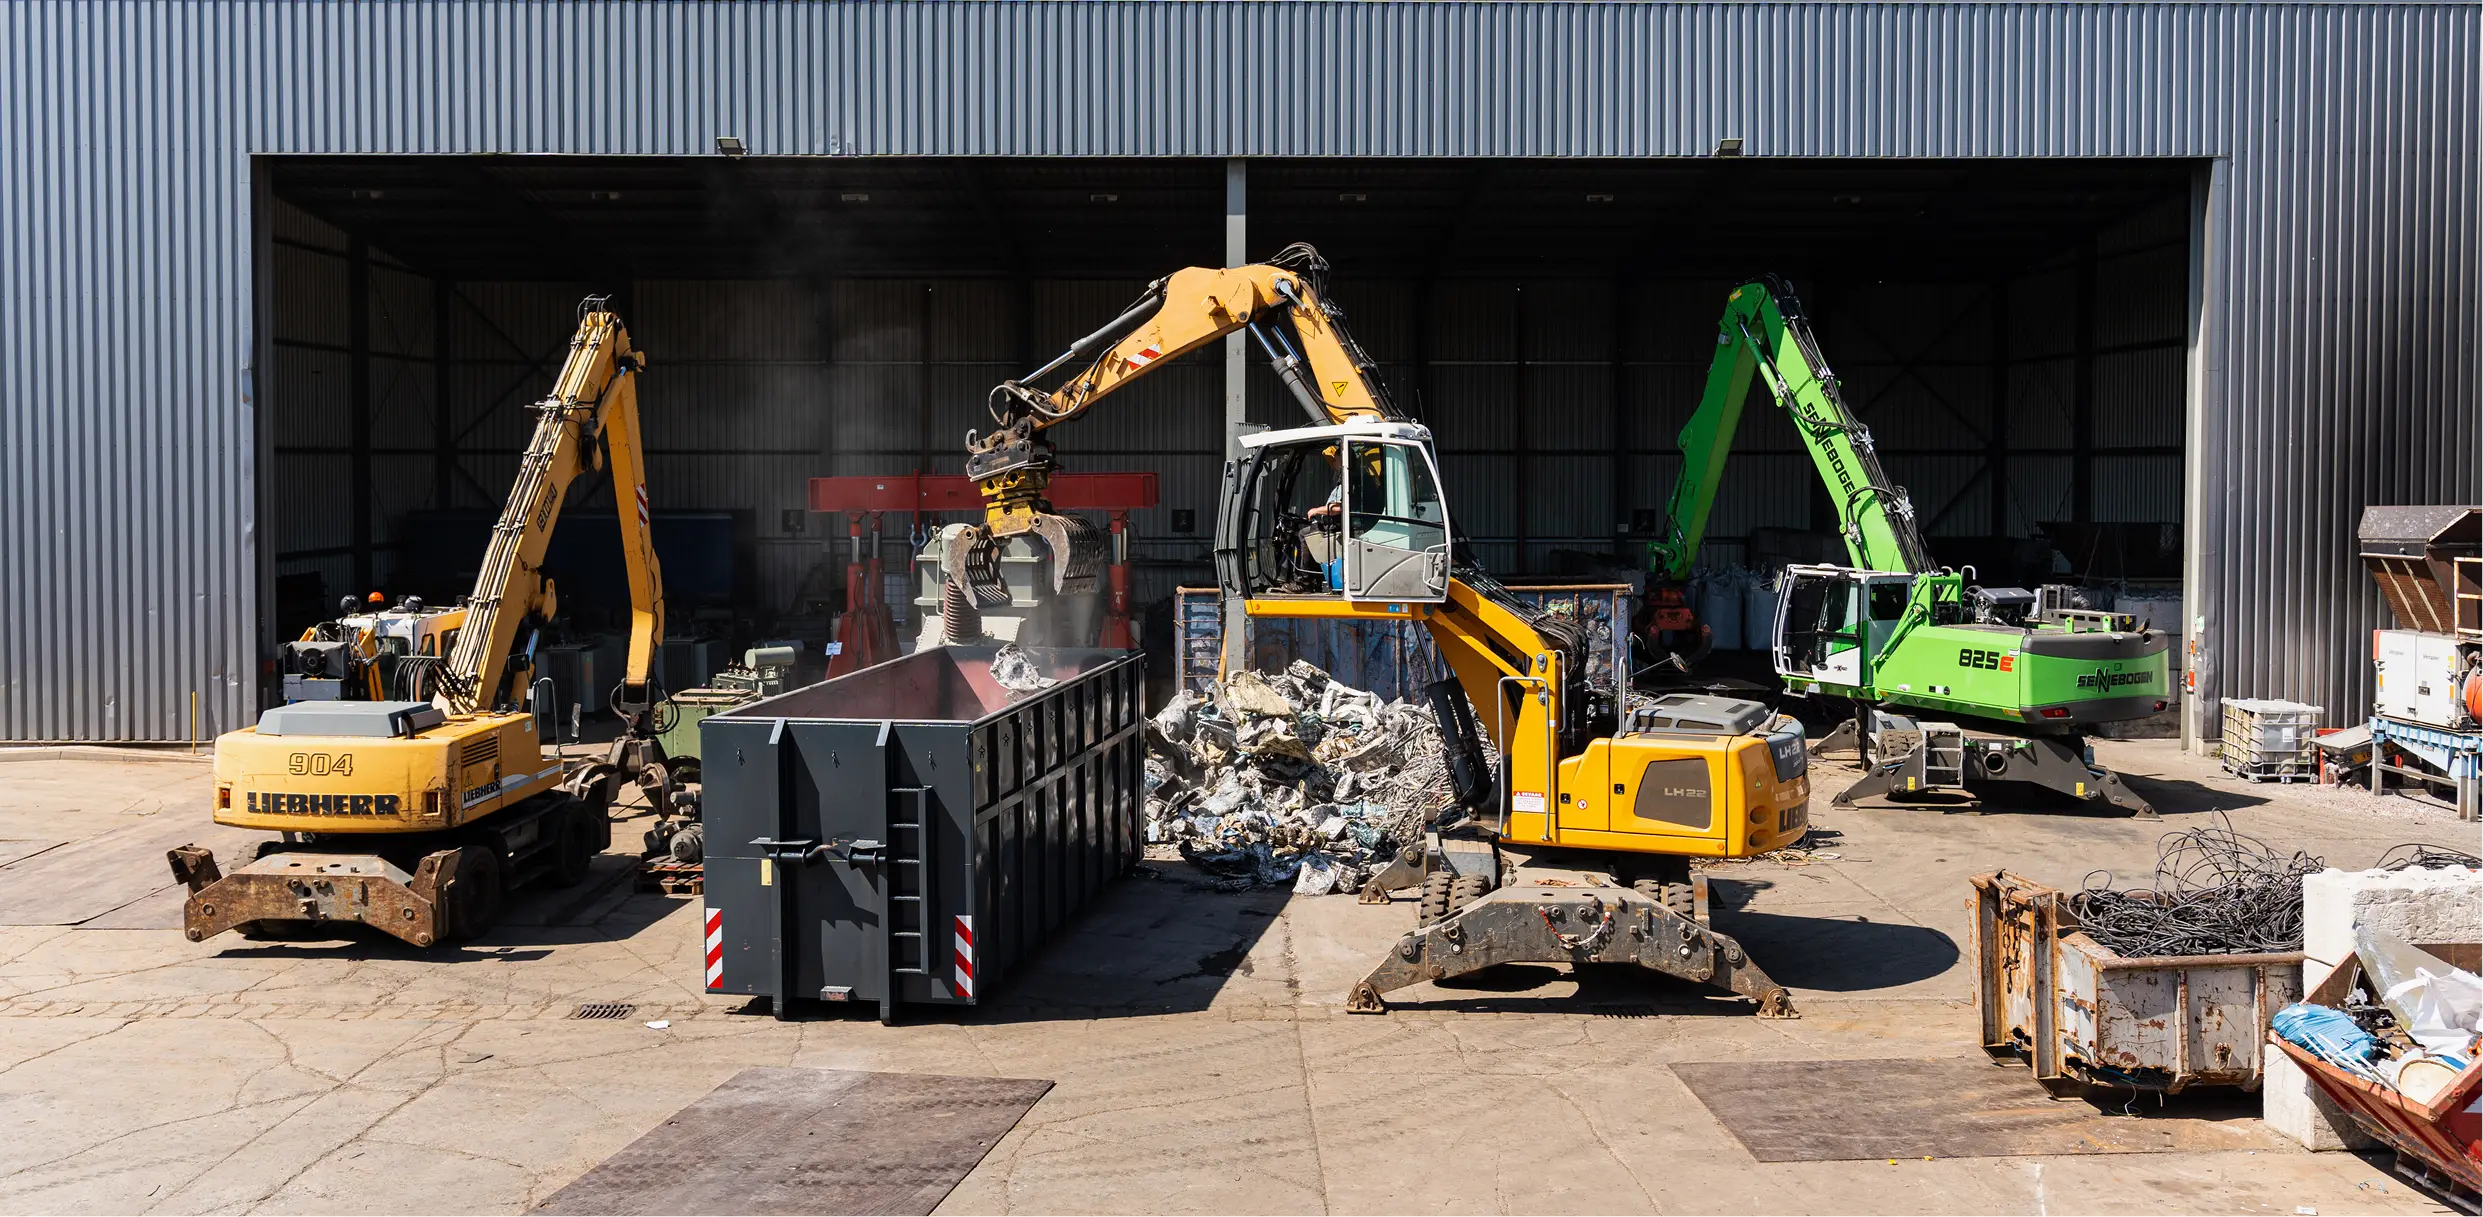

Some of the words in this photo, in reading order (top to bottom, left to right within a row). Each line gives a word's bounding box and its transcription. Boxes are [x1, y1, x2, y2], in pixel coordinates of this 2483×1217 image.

[1958, 648, 2015, 672] 825E
[2077, 667, 2153, 693] SENNEBOGEN
[289, 753, 353, 776] 904
[247, 791, 401, 816] LIEBHERR
[463, 780, 501, 803] LIEBHERR
